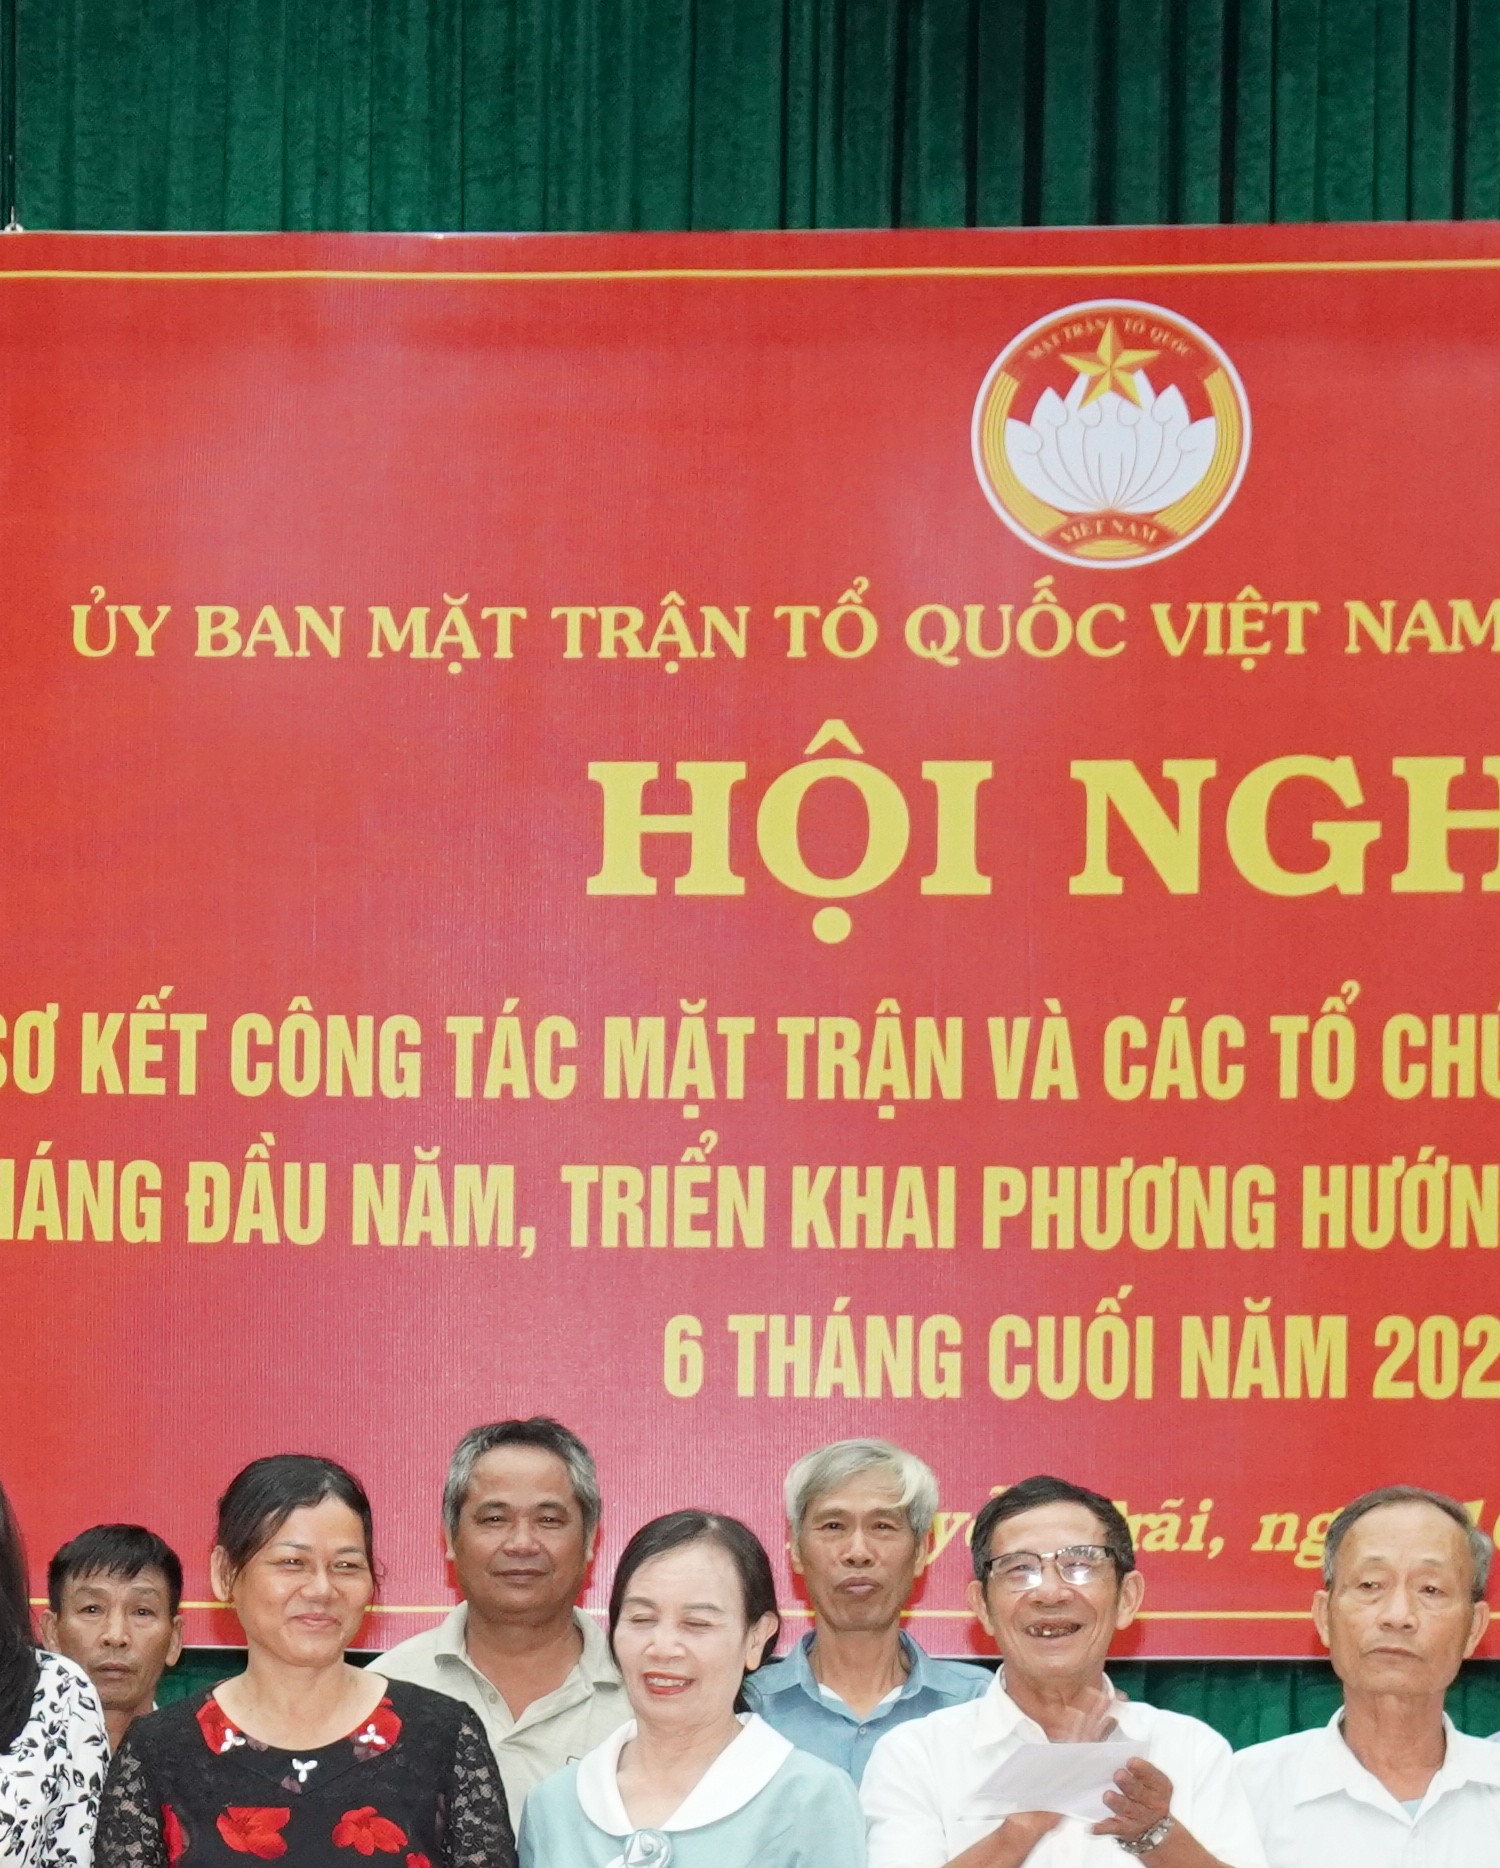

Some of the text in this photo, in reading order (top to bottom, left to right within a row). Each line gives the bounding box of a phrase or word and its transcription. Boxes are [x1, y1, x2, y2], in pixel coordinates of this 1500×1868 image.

[71, 584, 171, 657] ỦY
[195, 605, 344, 658] BAN
[368, 595, 527, 674] MẶT
[551, 591, 750, 673] TRẬN
[774, 577, 878, 658] TỔ
[905, 575, 1125, 666] QUỐC
[1151, 586, 1318, 670] VIỆT
[587, 719, 992, 944] HỘI
[81, 986, 207, 1095] KẾT
[231, 996, 421, 1098] CÔNG
[446, 998, 577, 1100] TÁC
[604, 999, 755, 1119] MẶT
[777, 999, 962, 1119] TRẬN
[988, 998, 1078, 1099] VÀ
[1104, 998, 1244, 1100] CÁC
[1270, 980, 1360, 1099] TỔ
[185, 1132, 326, 1247] ĐẦU
[352, 1147, 535, 1257] NĂM,
[561, 1130, 765, 1250] TRIỂN
[791, 1166, 955, 1251] KHAI
[983, 1157, 1275, 1252] PHƯƠNG
[664, 1315, 703, 1397] 6
[728, 1297, 962, 1399] THÁNG
[989, 1285, 1153, 1400] CUỐI
[1181, 1297, 1347, 1398] NĂM
[1112, 1497, 1224, 1559] rãi,
[1251, 1506, 1346, 1568] ng
